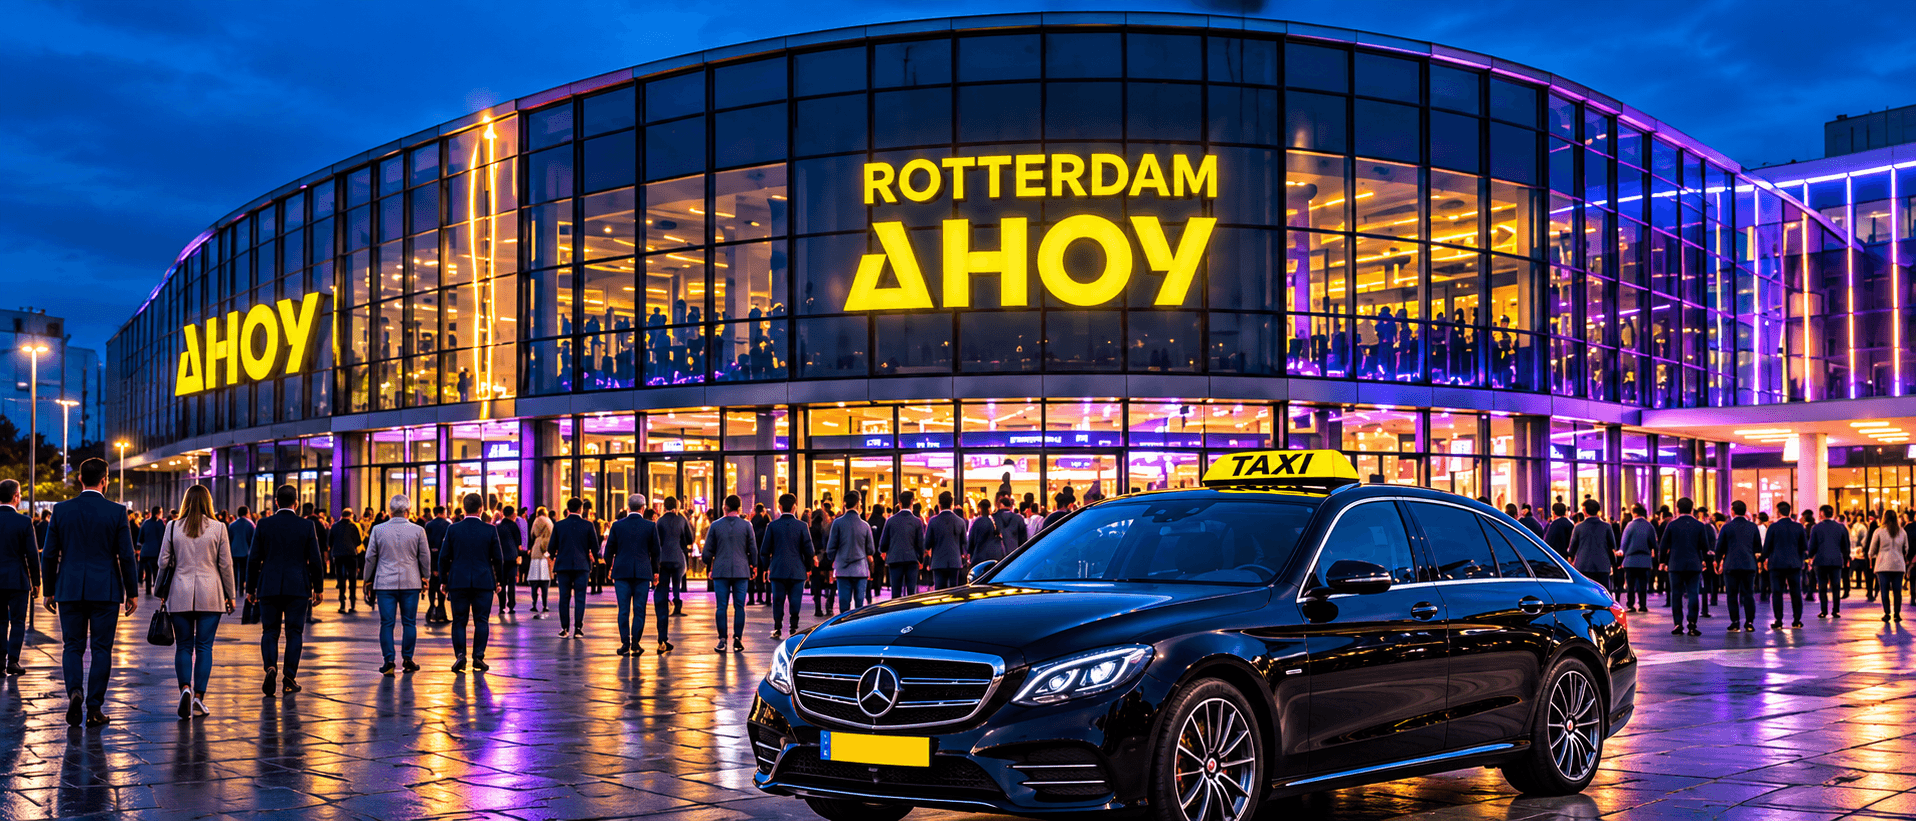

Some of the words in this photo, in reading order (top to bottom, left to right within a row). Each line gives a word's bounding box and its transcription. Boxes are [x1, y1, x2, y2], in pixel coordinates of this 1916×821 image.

[864, 153, 1218, 204] ROTTERDAM
[843, 214, 1218, 311] AHOY
[175, 291, 320, 397] AHOY
[1231, 453, 1314, 477] TAXI
